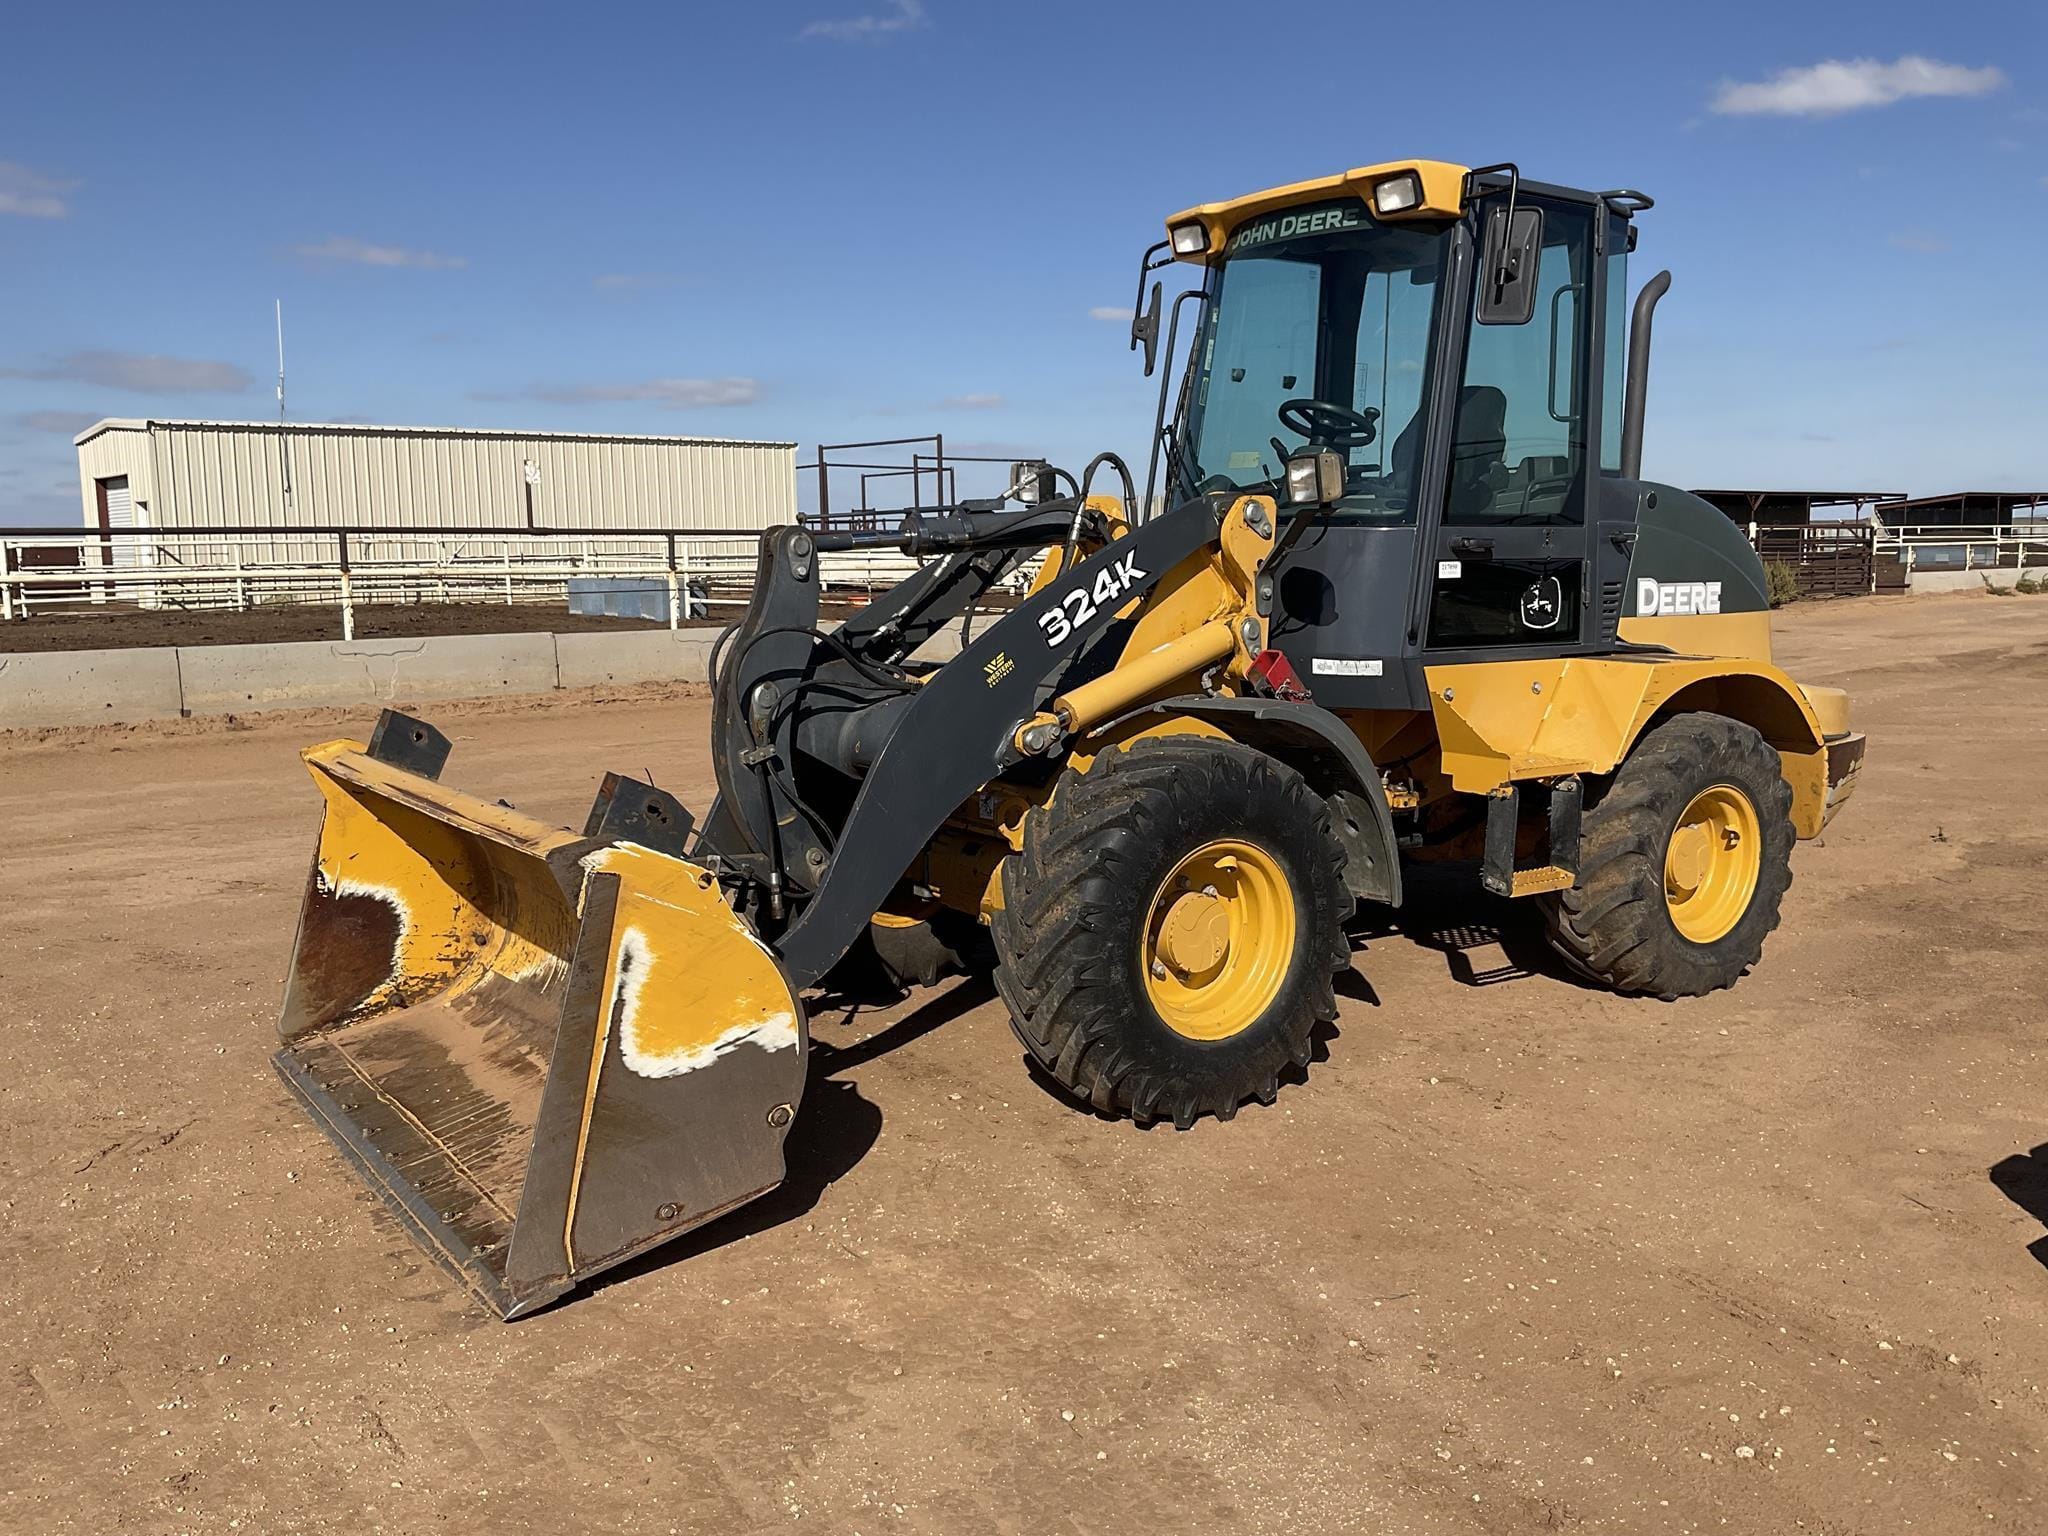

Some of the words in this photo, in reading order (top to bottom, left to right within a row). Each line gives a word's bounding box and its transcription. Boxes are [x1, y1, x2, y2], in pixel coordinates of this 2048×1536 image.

[1231, 222, 1277, 250] JOHN
[1279, 208, 1360, 238] DEERE
[1037, 546, 1149, 648] 324K
[1637, 577, 1722, 617] DEERE
[986, 658, 1014, 684] WESTERN
